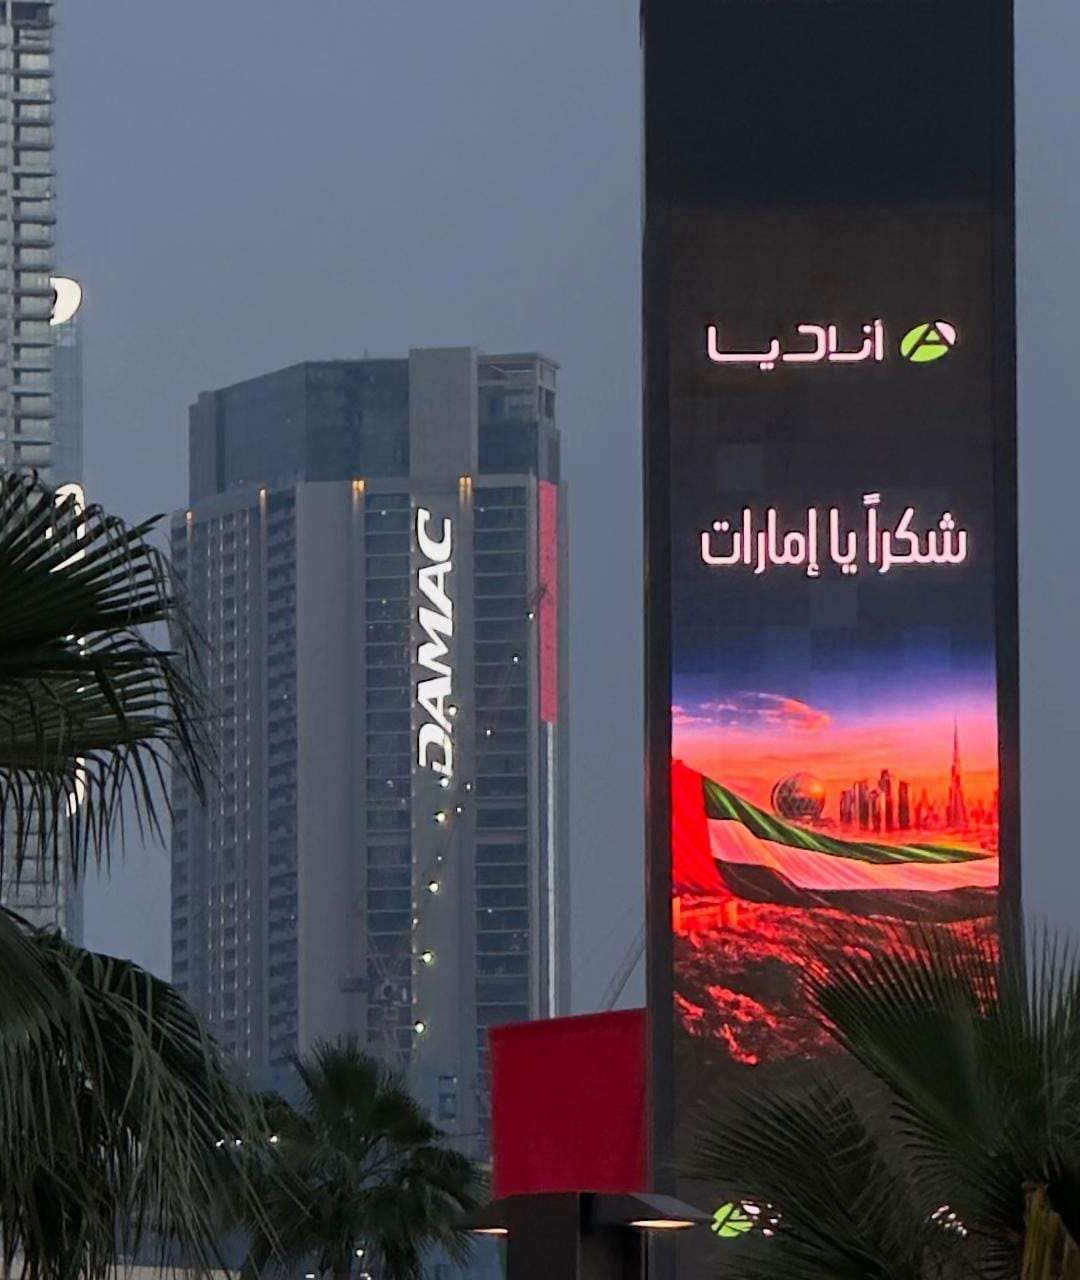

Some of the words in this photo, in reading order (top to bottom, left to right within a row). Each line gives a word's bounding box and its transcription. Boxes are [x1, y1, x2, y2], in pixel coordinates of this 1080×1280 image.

[701, 507, 820, 577] إمارات
[829, 507, 858, 575] يا
[417, 507, 454, 777] DAMAC
